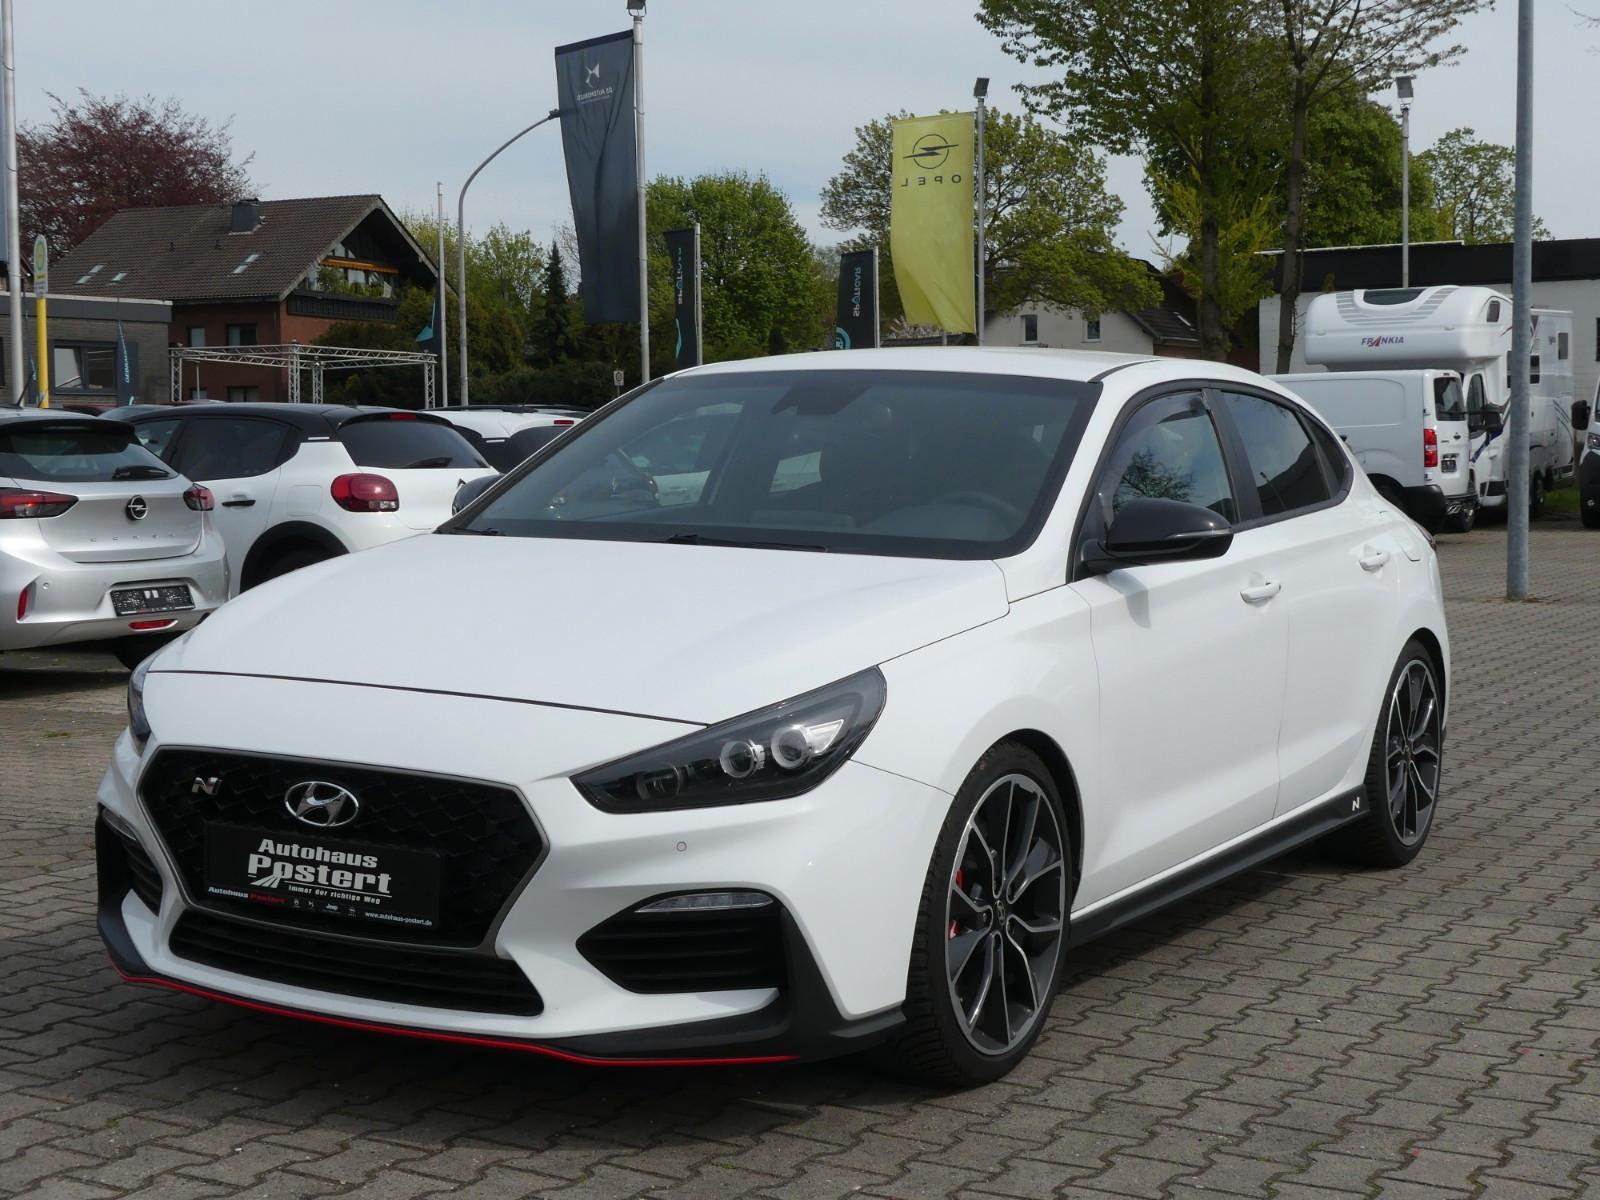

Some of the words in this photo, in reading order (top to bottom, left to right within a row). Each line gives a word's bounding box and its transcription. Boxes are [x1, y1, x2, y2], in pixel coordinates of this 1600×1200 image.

[1361, 335, 1404, 347] FRANKIA
[191, 776, 222, 796] N
[1351, 796, 1360, 811] N
[258, 838, 378, 868] Autohaus
[247, 853, 392, 893] Postert
[208, 886, 249, 898] Autohaus
[330, 892, 361, 901] richtige
[363, 895, 381, 905] Weg
[364, 911, 433, 926] www.autohaus-postert.de
